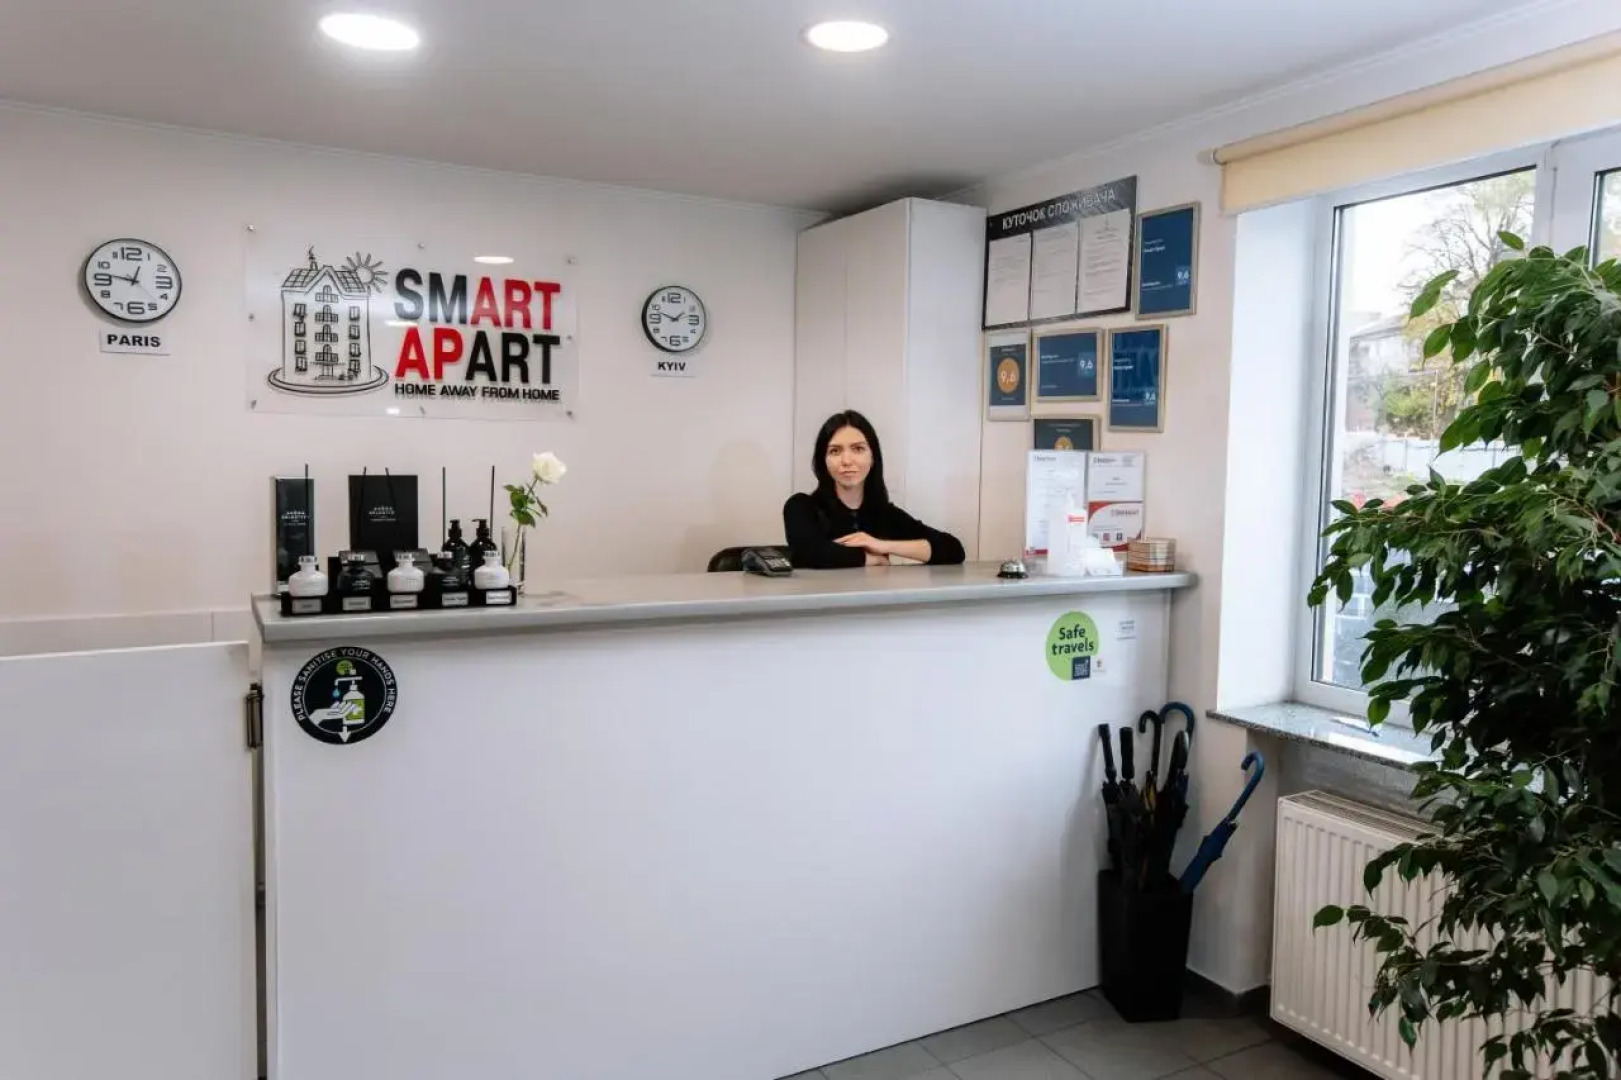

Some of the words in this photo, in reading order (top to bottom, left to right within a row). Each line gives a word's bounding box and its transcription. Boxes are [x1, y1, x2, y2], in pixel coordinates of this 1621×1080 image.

[1002, 207, 1046, 230] КУТОЧОК
[1047, 188, 1115, 217] СПОЖИВАЧА
[121, 247, 143, 261] 12
[97, 261, 111, 270] 10
[156, 264, 168, 273] 2
[94, 273, 113, 287] 9
[155, 275, 173, 290] 3
[394, 268, 561, 330] SMART
[667, 292, 681, 304] 12
[127, 301, 146, 315] 6
[688, 314, 700, 326] 3
[106, 333, 162, 348] PARIS
[669, 335, 681, 347] 6
[394, 326, 561, 385] APART
[657, 361, 686, 372] KYIV
[394, 383, 437, 397] HOME
[439, 384, 478, 398] AWAY
[481, 386, 520, 400] FROM
[522, 389, 560, 401] HOME
[1058, 623, 1087, 641] Safe
[340, 648, 370, 660] YOUR
[1051, 637, 1096, 656] travels
[298, 650, 337, 682] SANITISE
[370, 656, 394, 686] HANDS
[293, 684, 306, 721] PLEASE
[383, 688, 396, 714] HERE
